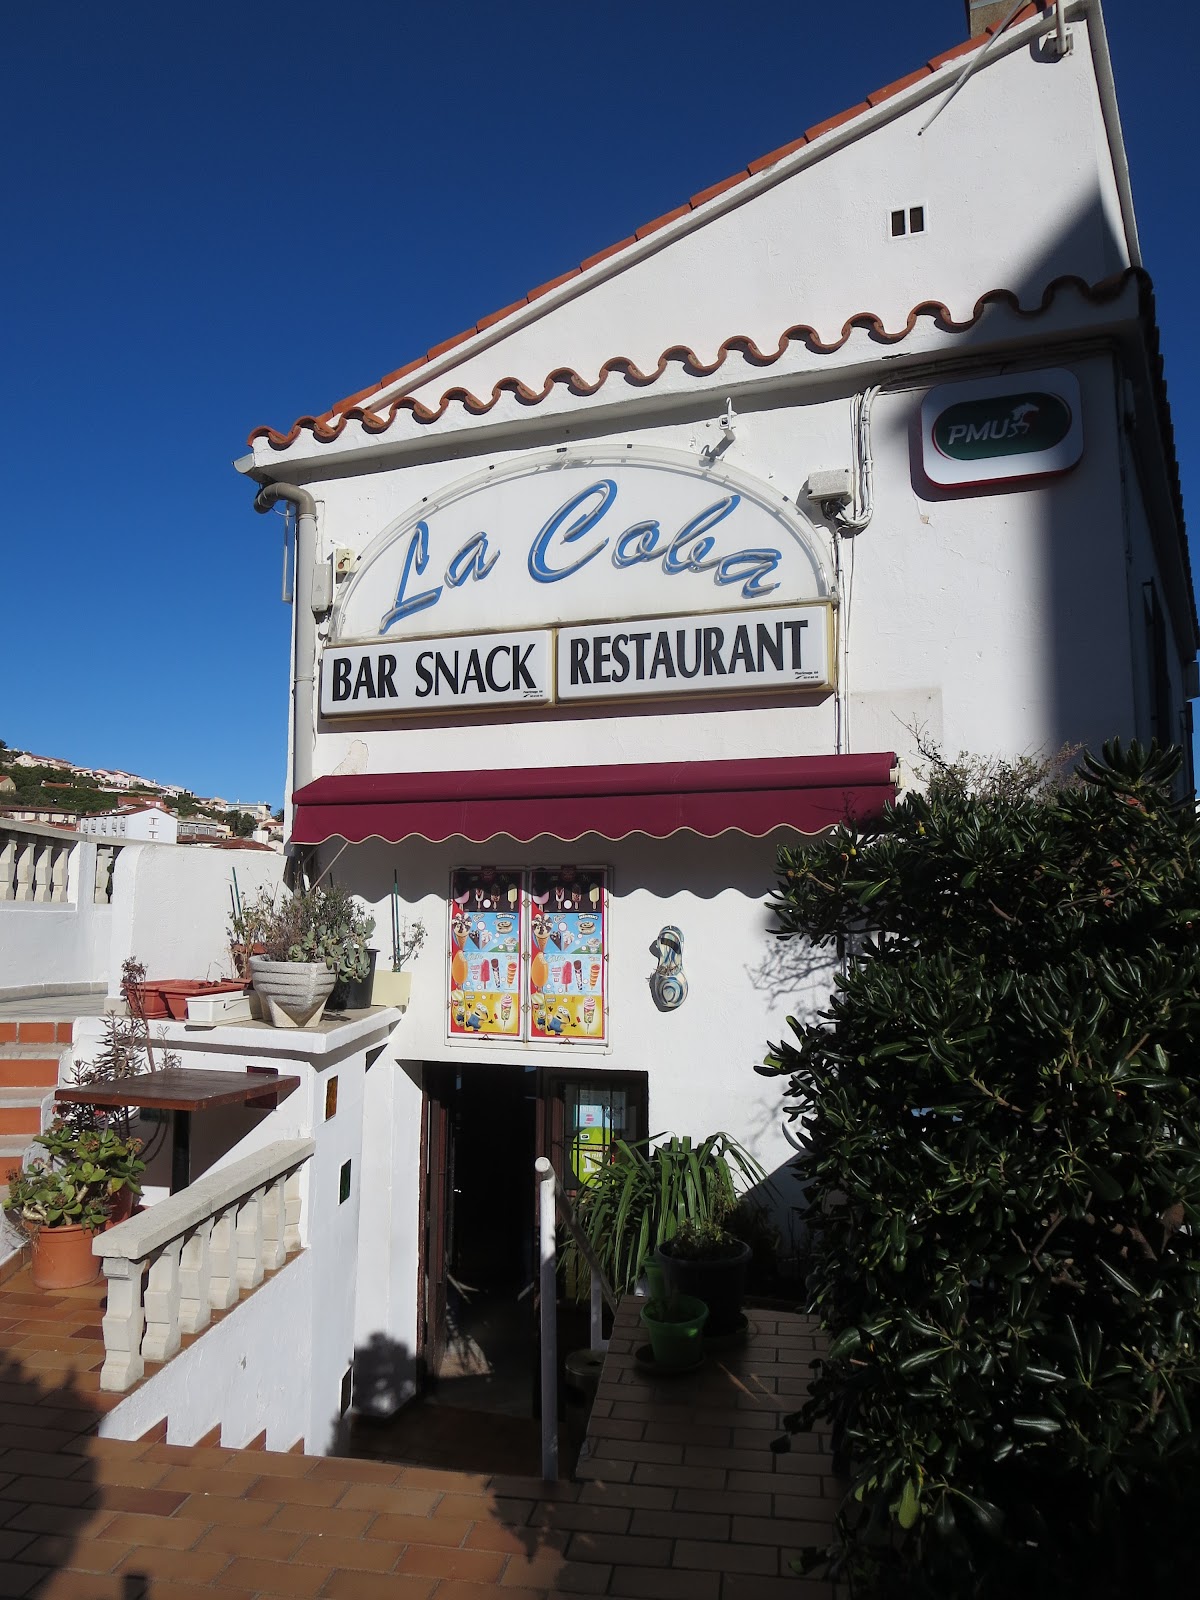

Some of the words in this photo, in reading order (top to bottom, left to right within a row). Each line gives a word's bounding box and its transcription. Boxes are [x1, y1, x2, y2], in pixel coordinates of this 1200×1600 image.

[948, 418, 1009, 445] PMU
[378, 521, 500, 633] La
[332, 654, 398, 702] BAR
[415, 643, 537, 698] SNACK
[570, 620, 809, 685] RESTAURANT
